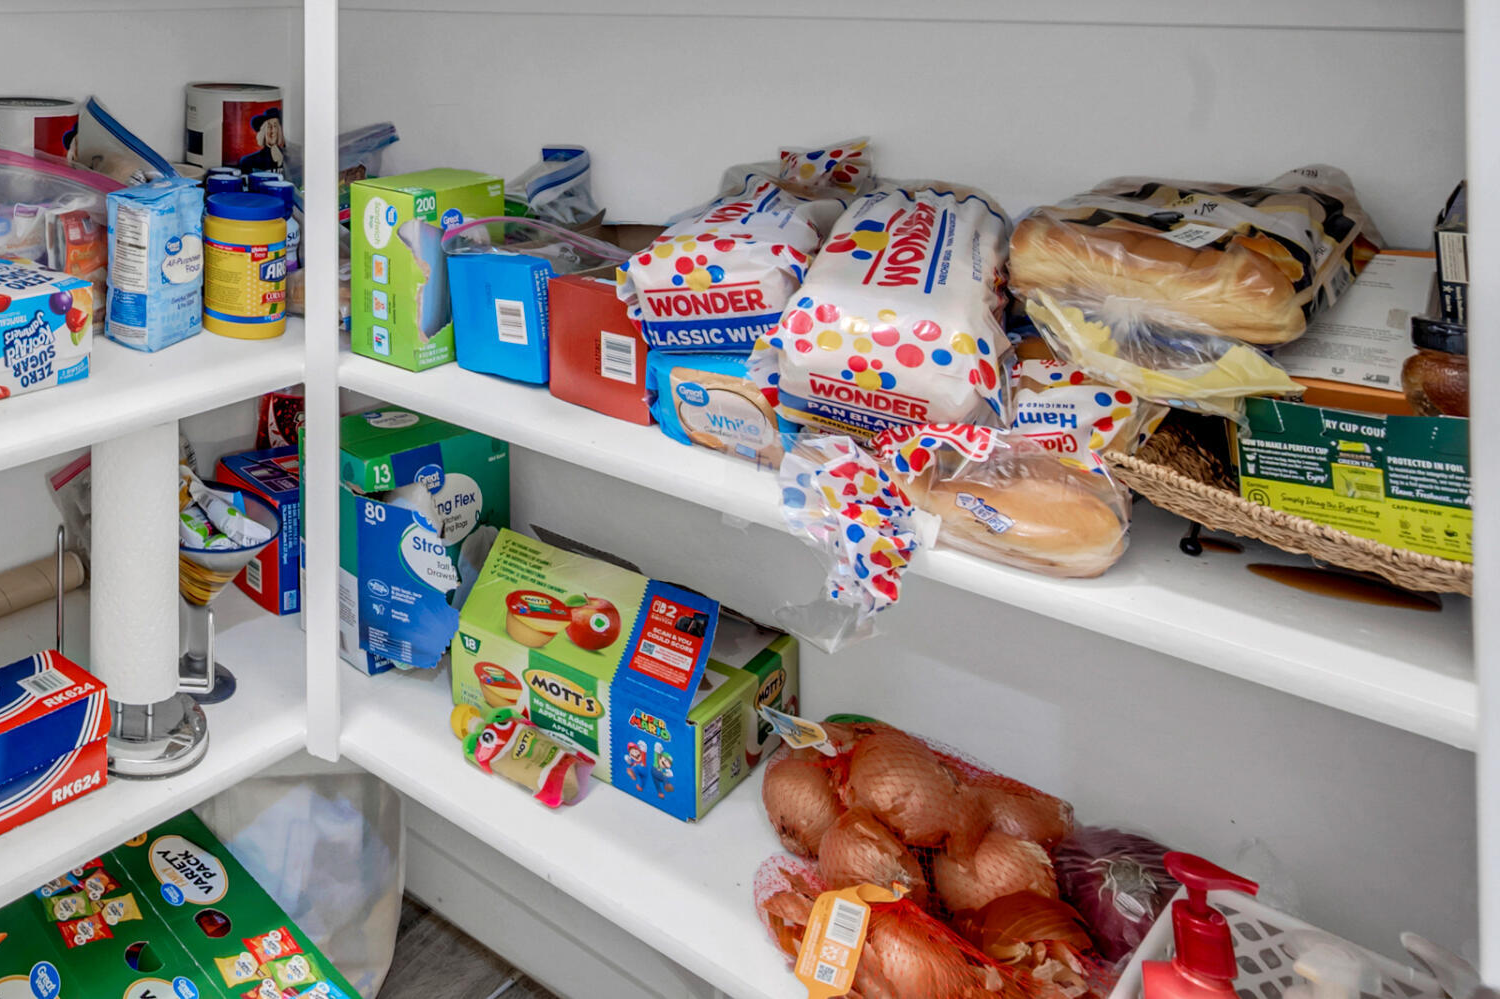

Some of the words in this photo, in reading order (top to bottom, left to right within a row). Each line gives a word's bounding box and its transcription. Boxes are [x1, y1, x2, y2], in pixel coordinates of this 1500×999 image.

[416, 196, 435, 212] 200
[876, 201, 937, 287] WONDER
[648, 288, 766, 317] WONDER
[13, 345, 56, 378] SUGAR
[20, 362, 54, 387] ZERO
[809, 378, 928, 421] WONDER
[706, 411, 759, 436] White
[1339, 422, 1358, 433] CUP
[1265, 440, 1281, 449] MAKE
[1282, 442, 1286, 450] A
[1287, 443, 1314, 454] PERFECT
[373, 464, 391, 483] 13
[1387, 456, 1434, 469] PROTECTED
[1434, 461, 1444, 470] IN
[1446, 463, 1466, 473] FOIL
[1306, 472, 1328, 484] Enjoy!
[364, 502, 386, 522] 80
[665, 605, 677, 619] 2
[463, 636, 477, 651] 18
[647, 631, 670, 644] COULD
[671, 642, 694, 653] SCORE
[42, 682, 95, 708] RK624
[531, 675, 596, 713] MOTT'S
[757, 670, 786, 706] MOTT'S
[533, 698, 545, 706] No
[547, 702, 567, 717] Sugar
[568, 714, 594, 730] Added
[538, 708, 589, 736] APPLESAUCE
[635, 708, 666, 728] SUPER
[552, 723, 575, 738] APPLE
[629, 718, 671, 741] MARIO
[51, 770, 101, 805] RK624
[156, 849, 214, 895] VARIETY
[177, 849, 217, 879] PACK
